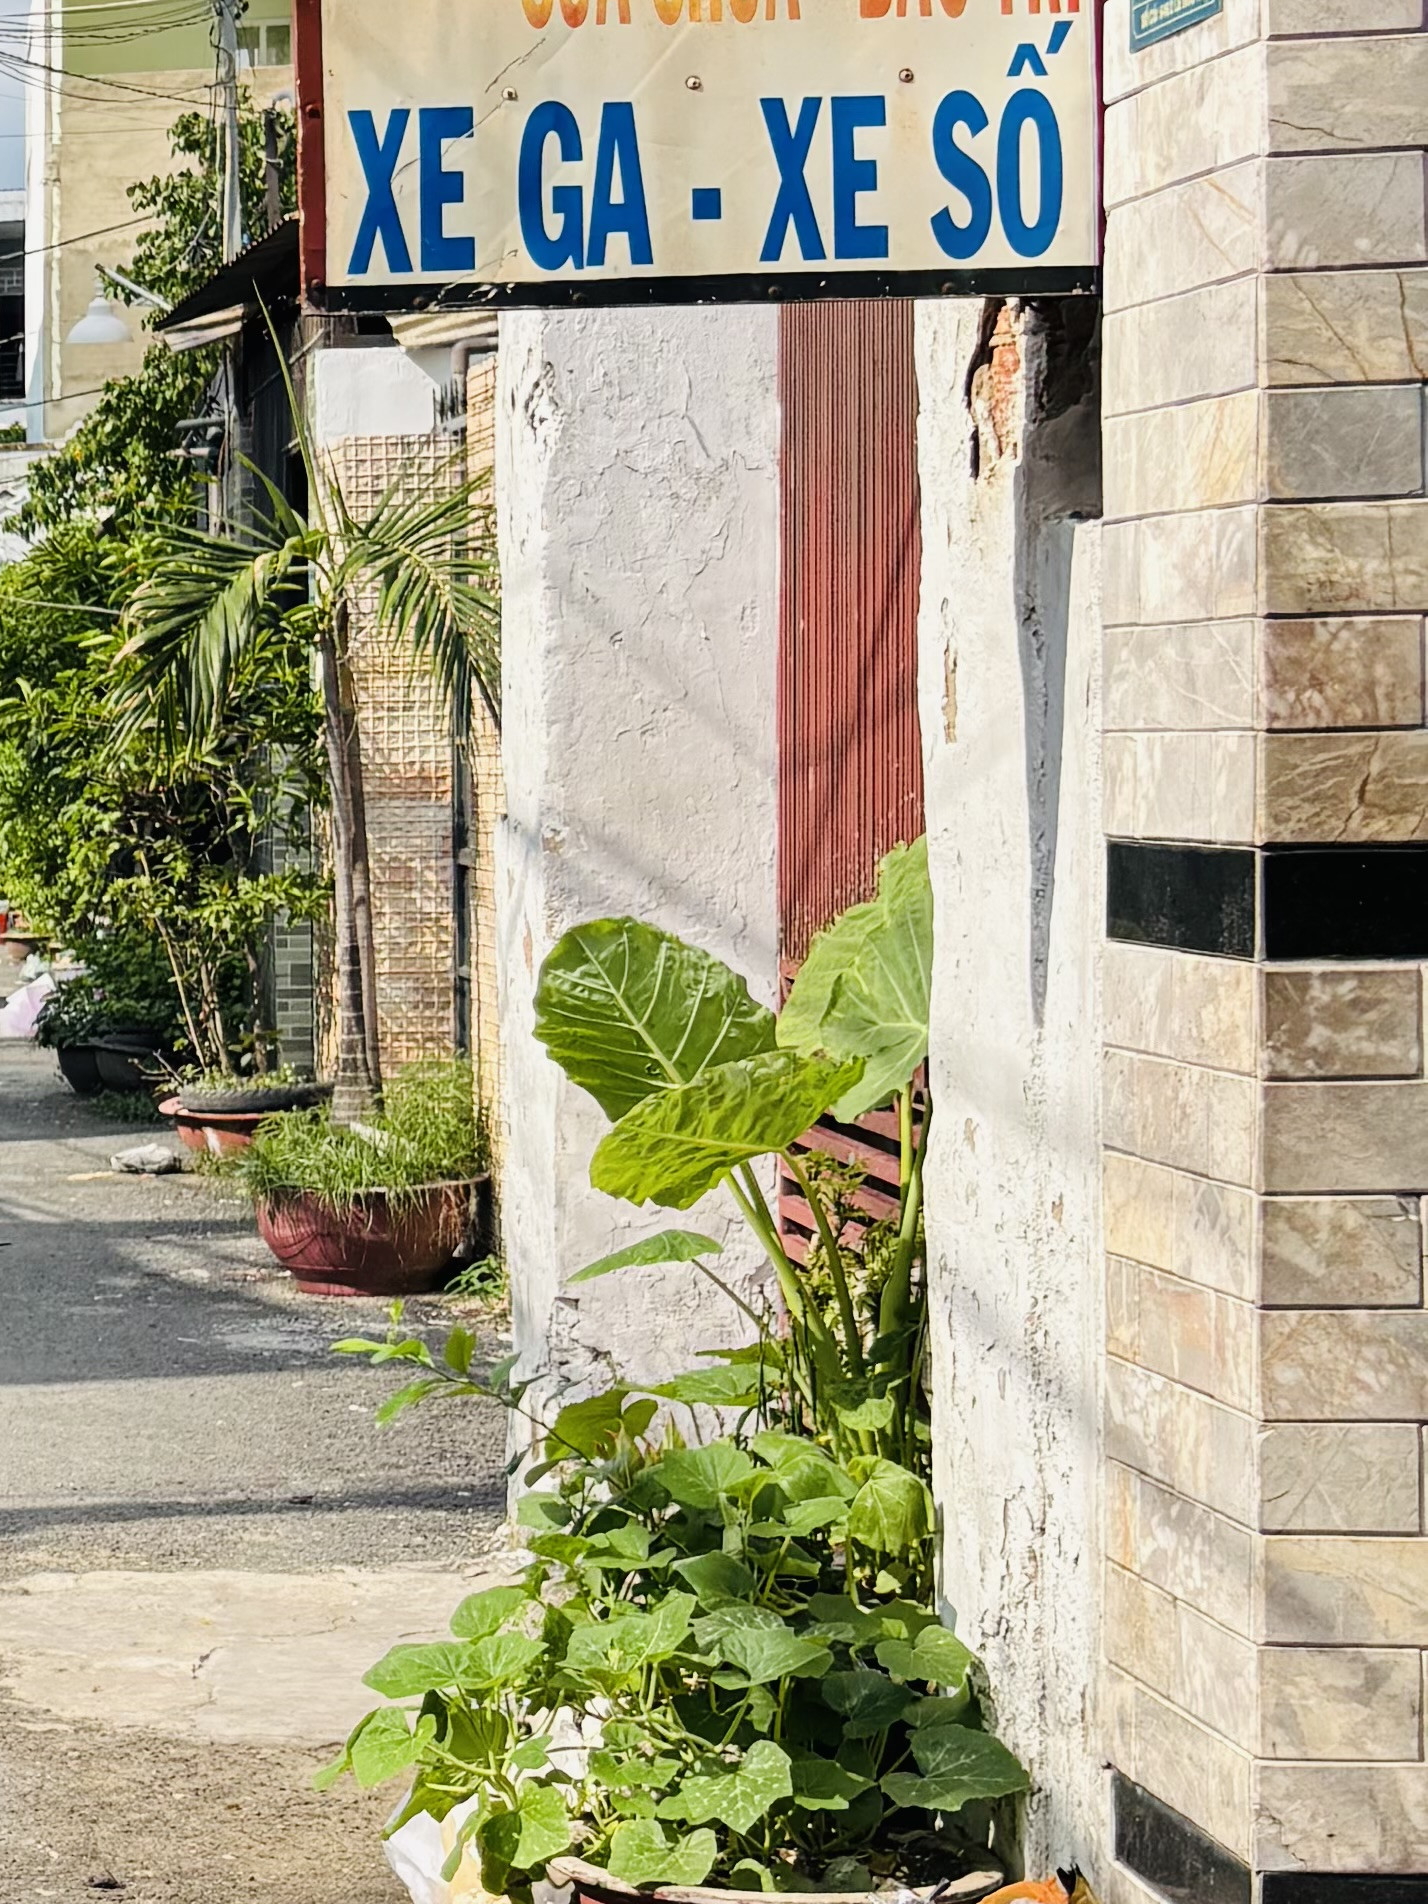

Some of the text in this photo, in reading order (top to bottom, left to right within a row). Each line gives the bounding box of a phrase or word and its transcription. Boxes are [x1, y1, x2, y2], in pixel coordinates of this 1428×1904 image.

[347, 106, 476, 275] XE
[517, 100, 654, 271] GA
[759, 94, 890, 262] XE
[929, 20, 1074, 260] SỐ
